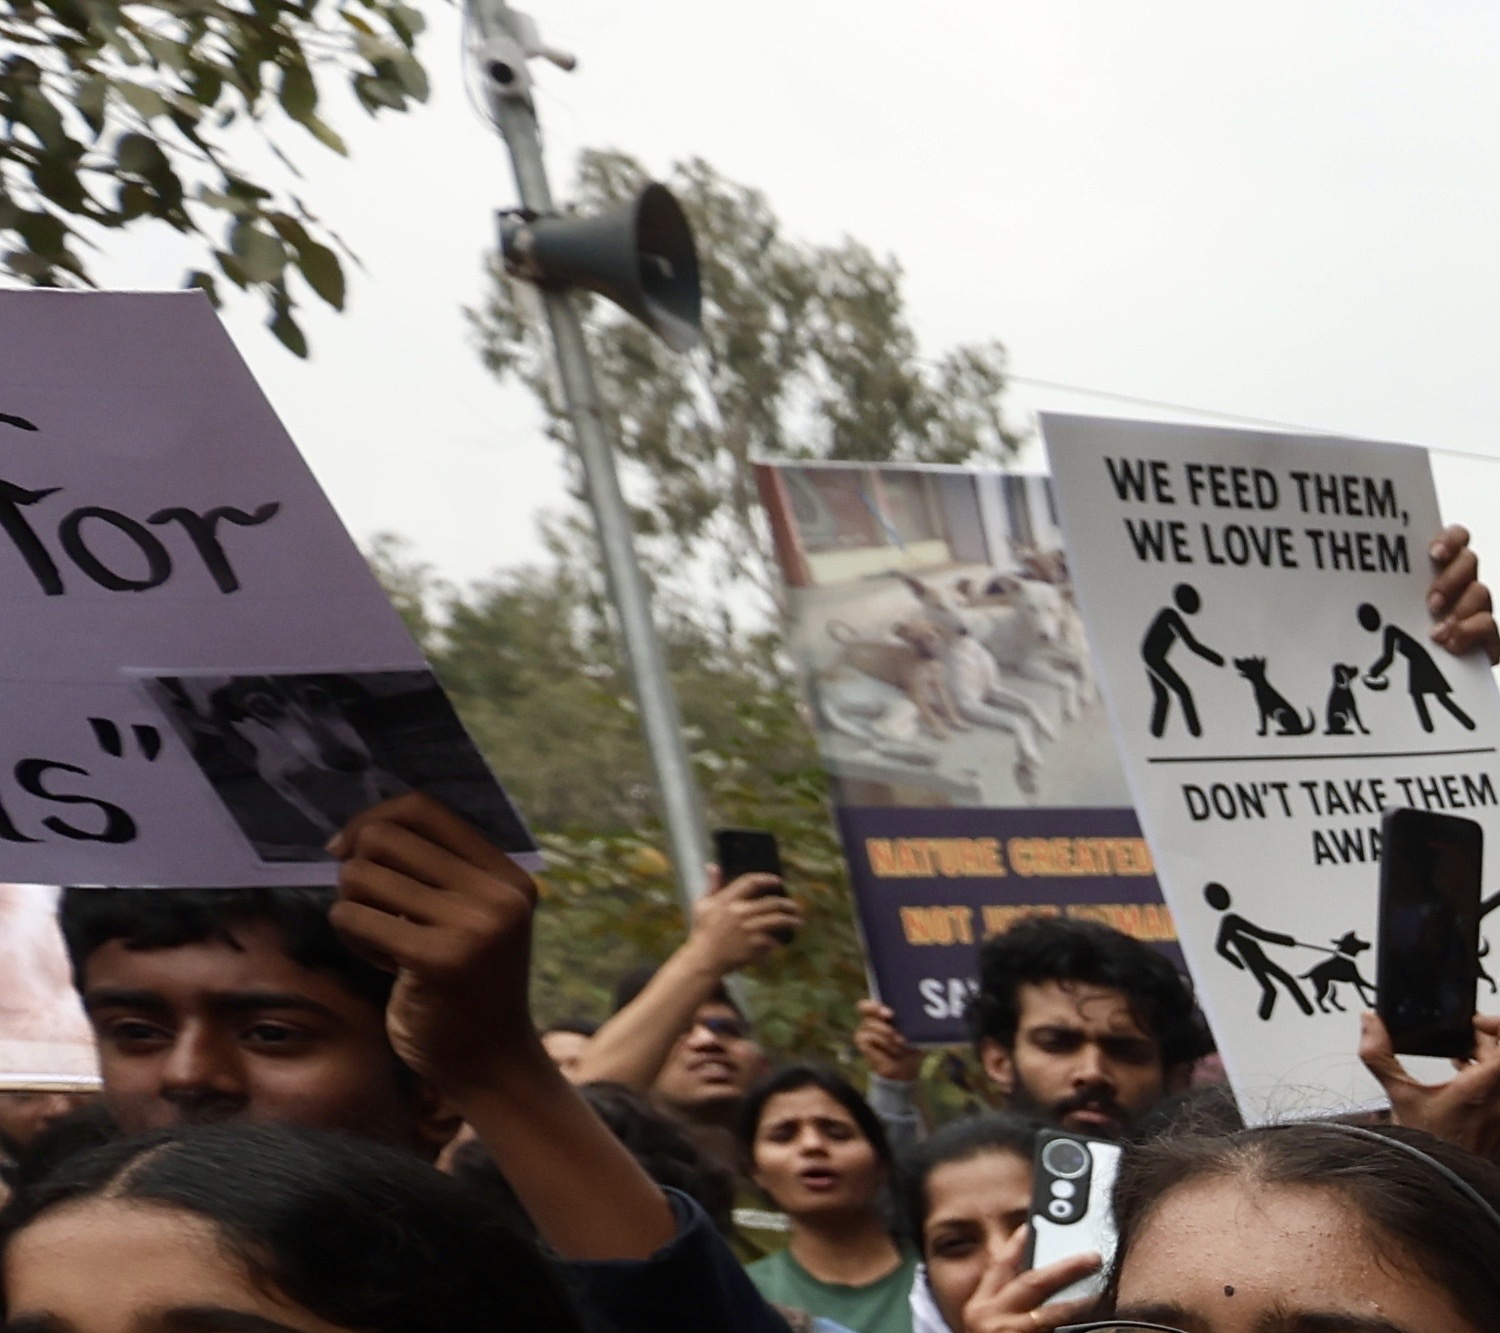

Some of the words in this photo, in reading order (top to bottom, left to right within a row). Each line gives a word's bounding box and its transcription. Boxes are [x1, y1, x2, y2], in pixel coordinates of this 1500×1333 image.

[1104, 457, 1175, 506] WE
[1187, 464, 1279, 513] FEED
[1290, 470, 1411, 527] THEM,
[1125, 517, 1192, 564] WE
[1200, 522, 1298, 570] LOVE
[1307, 527, 1412, 575] THEM
[1181, 782, 1292, 822] DON'T
[1300, 779, 1387, 816] TAKE
[1396, 772, 1499, 811] THEM
[865, 837, 1007, 877] NATURE
[1312, 827, 1384, 865] AWA
[900, 905, 974, 945] NOT
